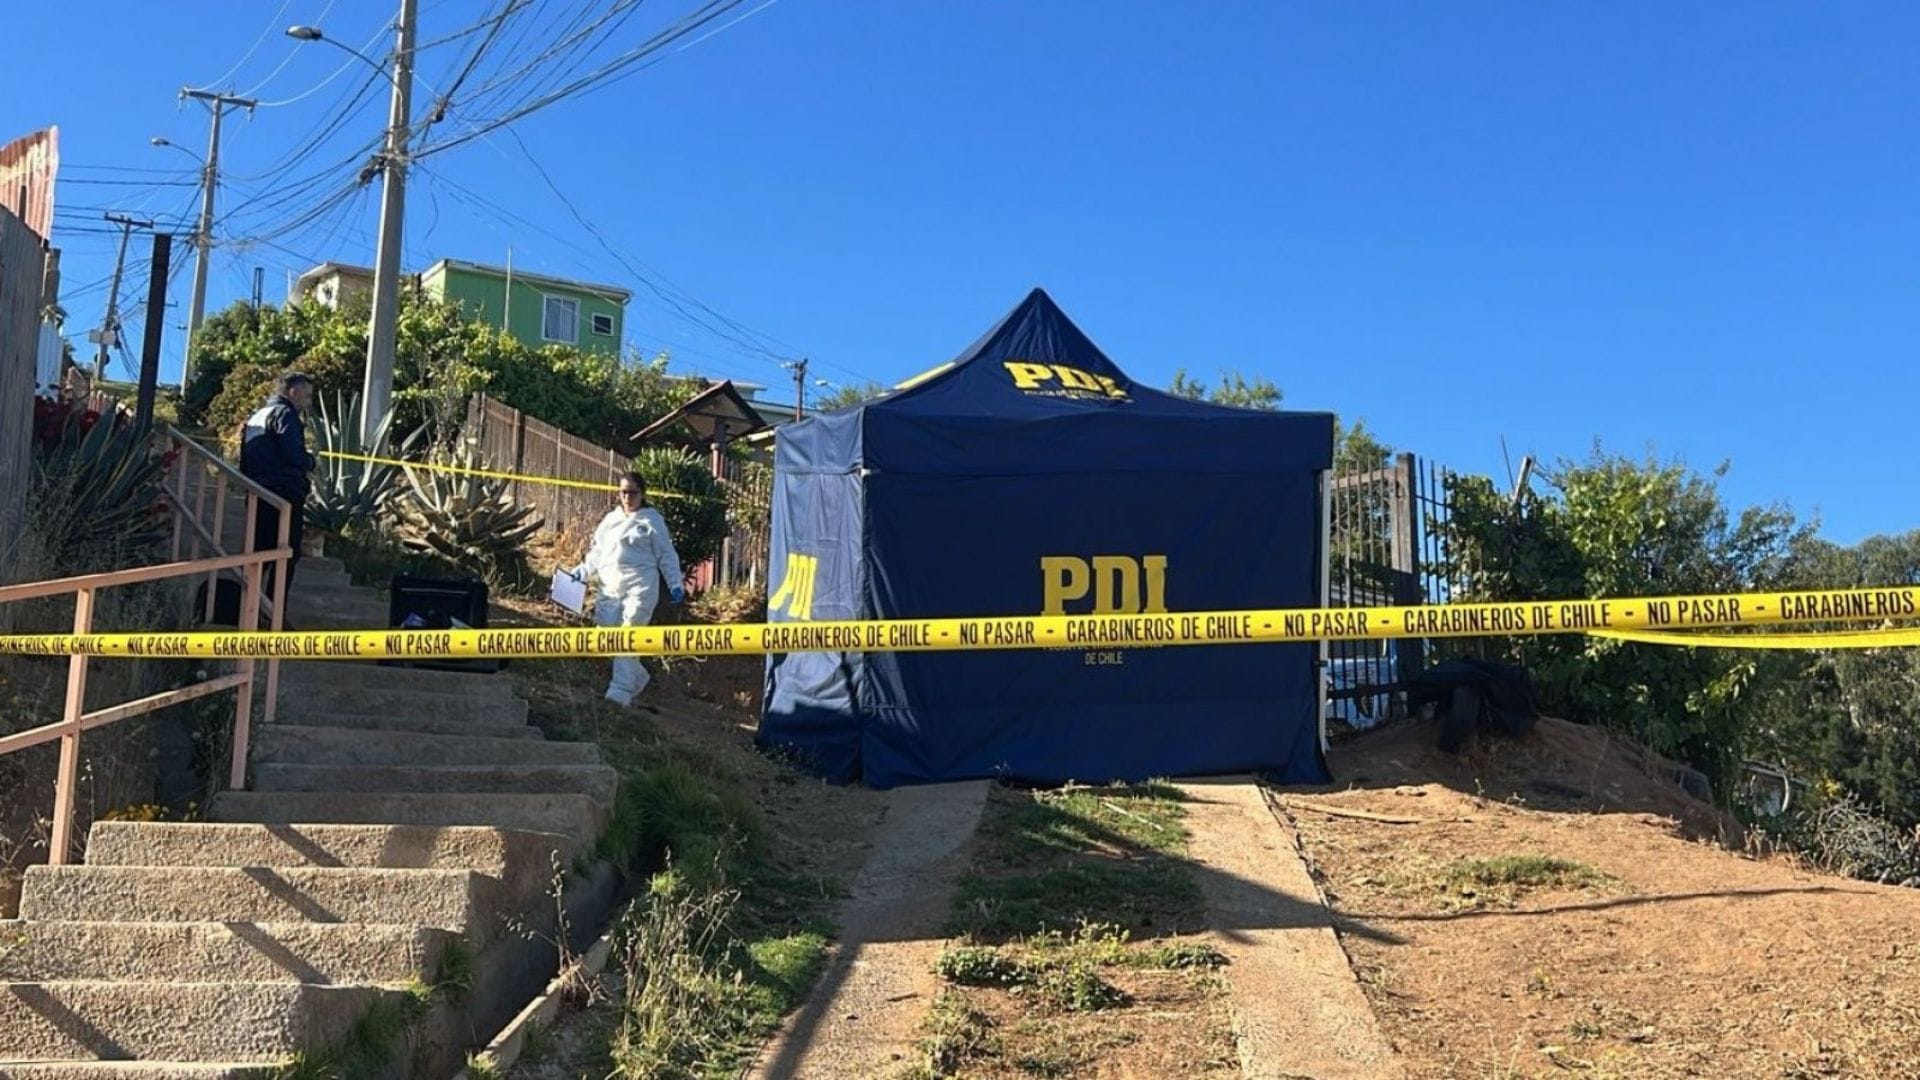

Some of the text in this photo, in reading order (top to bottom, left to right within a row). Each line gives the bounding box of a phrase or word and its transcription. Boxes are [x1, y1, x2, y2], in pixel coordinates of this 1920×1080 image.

[1041, 555, 1168, 616] PDI
[52, 637, 66, 653] DE
[71, 637, 105, 655] CHILE
[127, 637, 143, 655] NO
[147, 637, 189, 655] PASAR
[213, 636, 299, 656] CARABINEROS
[304, 636, 320, 656] DE
[324, 635, 361, 655] CHILE
[385, 634, 401, 655] NO
[407, 633, 450, 655] PASAR
[478, 632, 570, 654] CARABINEROS
[576, 632, 592, 652] DE
[598, 631, 636, 652] CHILE
[664, 630, 680, 651] NO
[686, 629, 733, 650] PASAR
[762, 625, 861, 650] CARABINEROS
[867, 625, 884, 648] DE
[889, 624, 931, 647] CHILE
[960, 622, 978, 645] NO
[984, 621, 1035, 644] PASAR
[1067, 617, 1175, 643] CARABINEROS
[1181, 617, 1200, 640] DE
[1207, 615, 1252, 640] CHILE
[1284, 614, 1305, 638] NO
[1312, 612, 1368, 636] PASAR
[1404, 606, 1526, 634] CARABINEROS
[1533, 605, 1554, 630] DE
[1560, 603, 1612, 629] CHILE
[1647, 601, 1671, 625] NO
[1678, 598, 1741, 624] PASAR
[1780, 591, 1915, 620] CARABINEROS
[1085, 651, 1123, 665] DE CHILE
